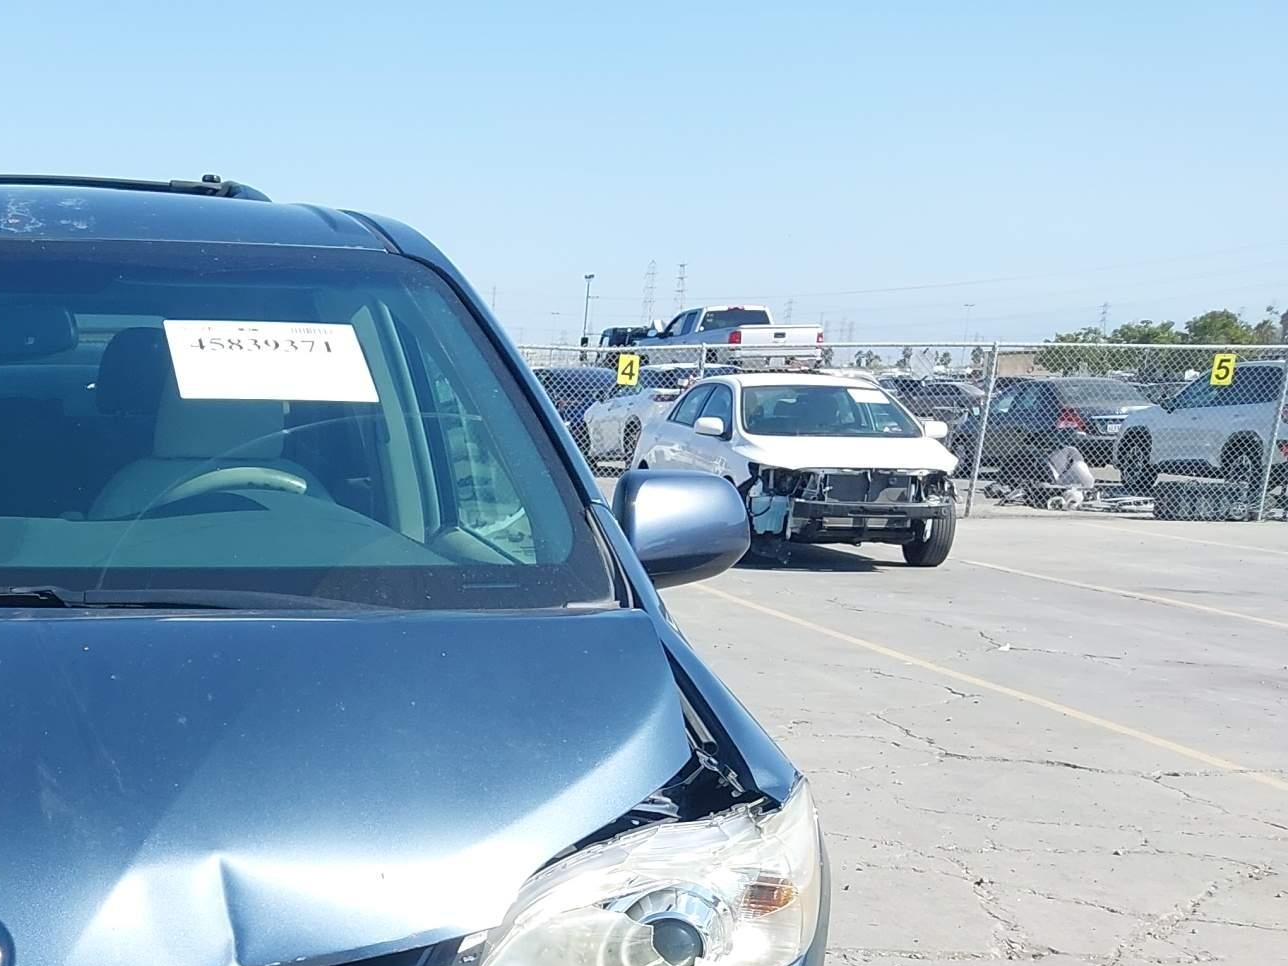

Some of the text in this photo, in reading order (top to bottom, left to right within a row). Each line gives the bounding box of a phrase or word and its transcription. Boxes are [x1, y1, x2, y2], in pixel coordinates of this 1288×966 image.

[190, 337, 333, 353] 45839371
[621, 359, 636, 380] 4
[1214, 358, 1231, 381] 5
